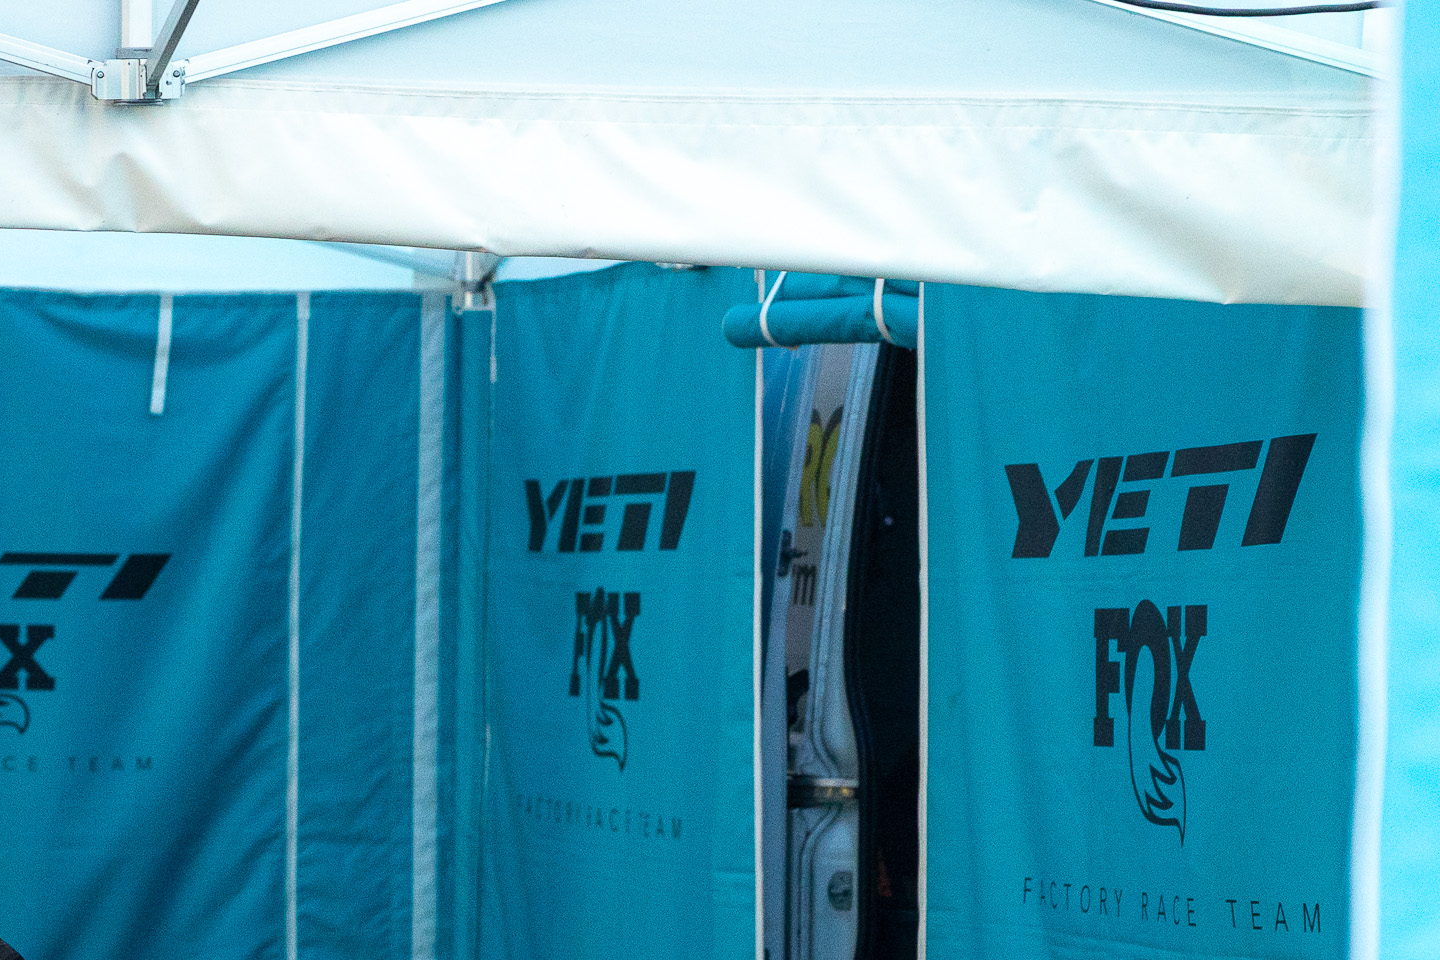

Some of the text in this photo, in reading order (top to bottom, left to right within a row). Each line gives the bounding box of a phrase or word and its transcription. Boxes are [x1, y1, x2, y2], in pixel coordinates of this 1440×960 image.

[524, 471, 695, 553] YETI
[1004, 433, 1318, 559] YETI
[568, 587, 641, 772] FOX
[1093, 600, 1207, 848] FOX
[1023, 876, 1322, 934] FACTORY RACE TEAM
